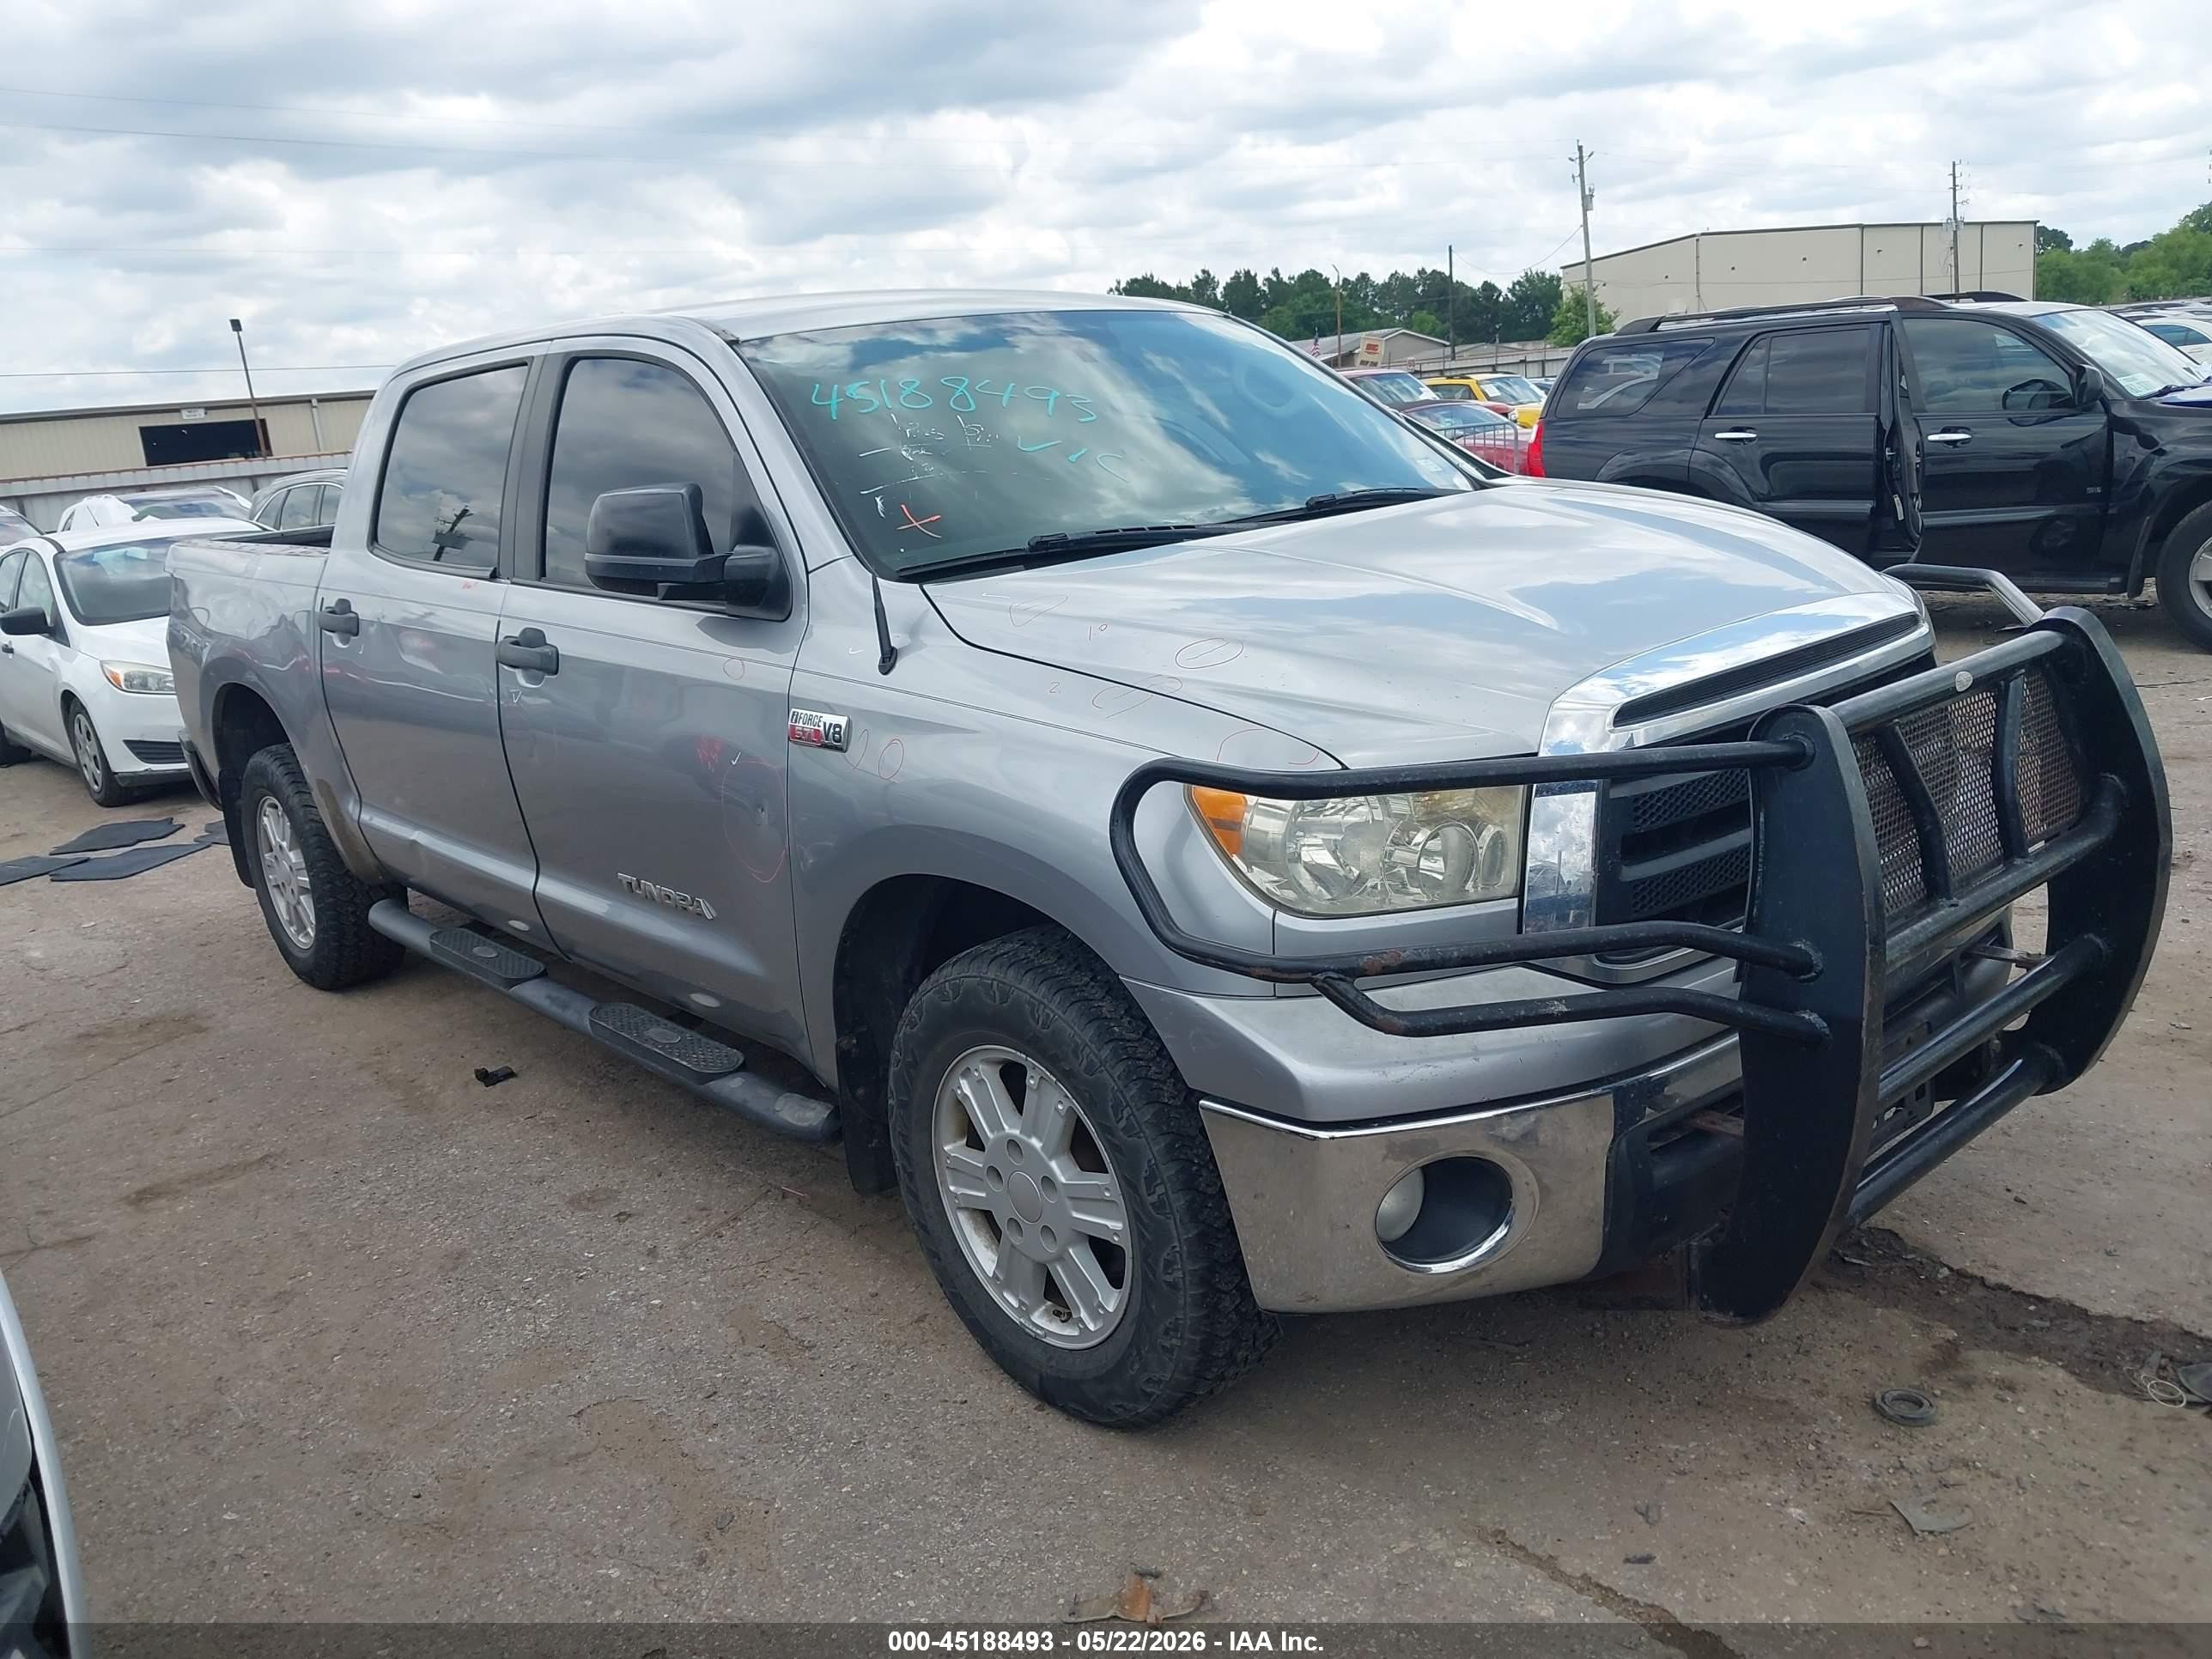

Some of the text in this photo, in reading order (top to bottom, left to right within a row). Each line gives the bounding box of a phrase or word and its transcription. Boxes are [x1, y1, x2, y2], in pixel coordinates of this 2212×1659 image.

[811, 376, 1097, 423] 45188493
[823, 721, 842, 744] V8
[617, 872, 717, 921] TUNDRA
